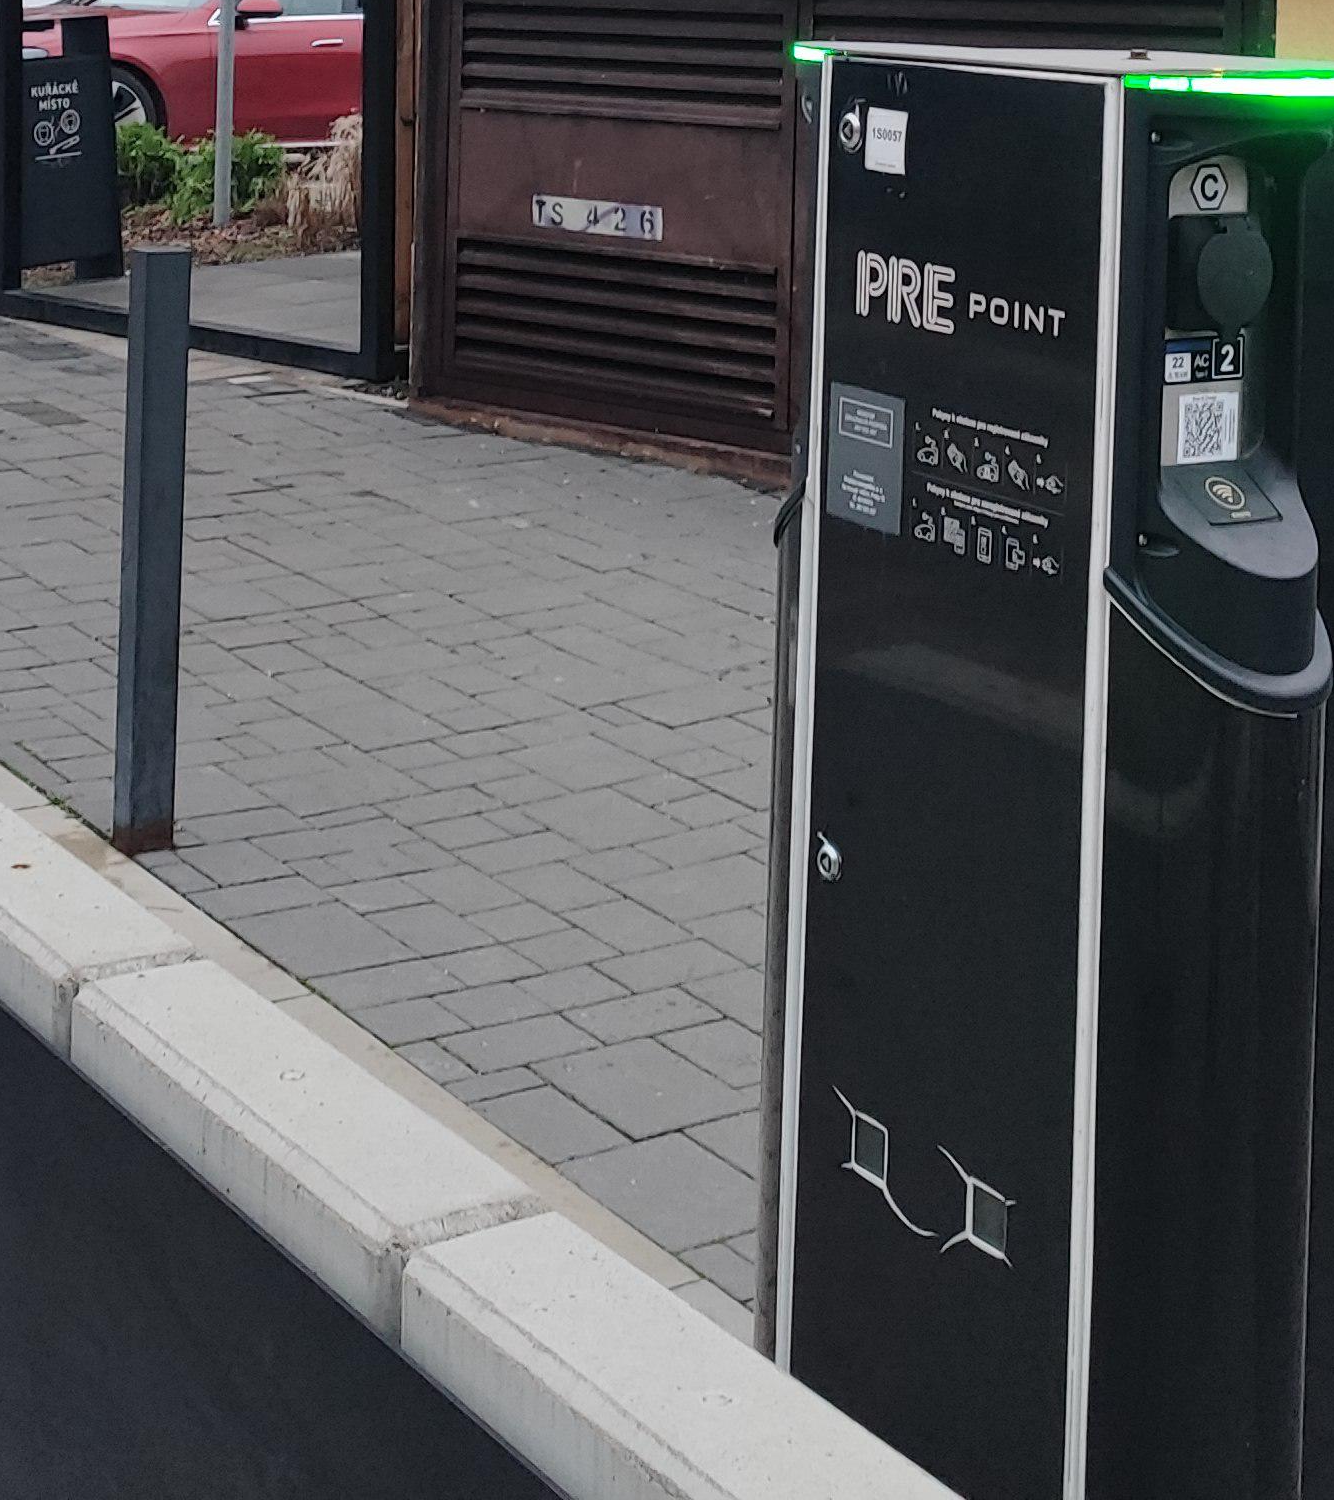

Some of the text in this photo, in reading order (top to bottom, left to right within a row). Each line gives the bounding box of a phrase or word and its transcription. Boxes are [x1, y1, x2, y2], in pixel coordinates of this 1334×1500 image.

[38, 96, 70, 111] MÍSTO
[872, 127, 903, 142] 1S0057
[1200, 173, 1219, 201] C
[535, 199, 564, 226] TS
[855, 249, 1066, 337] PRE POINT
[1172, 356, 1185, 369] 22
[1193, 353, 1210, 368] AC
[1219, 344, 1235, 373] 2
